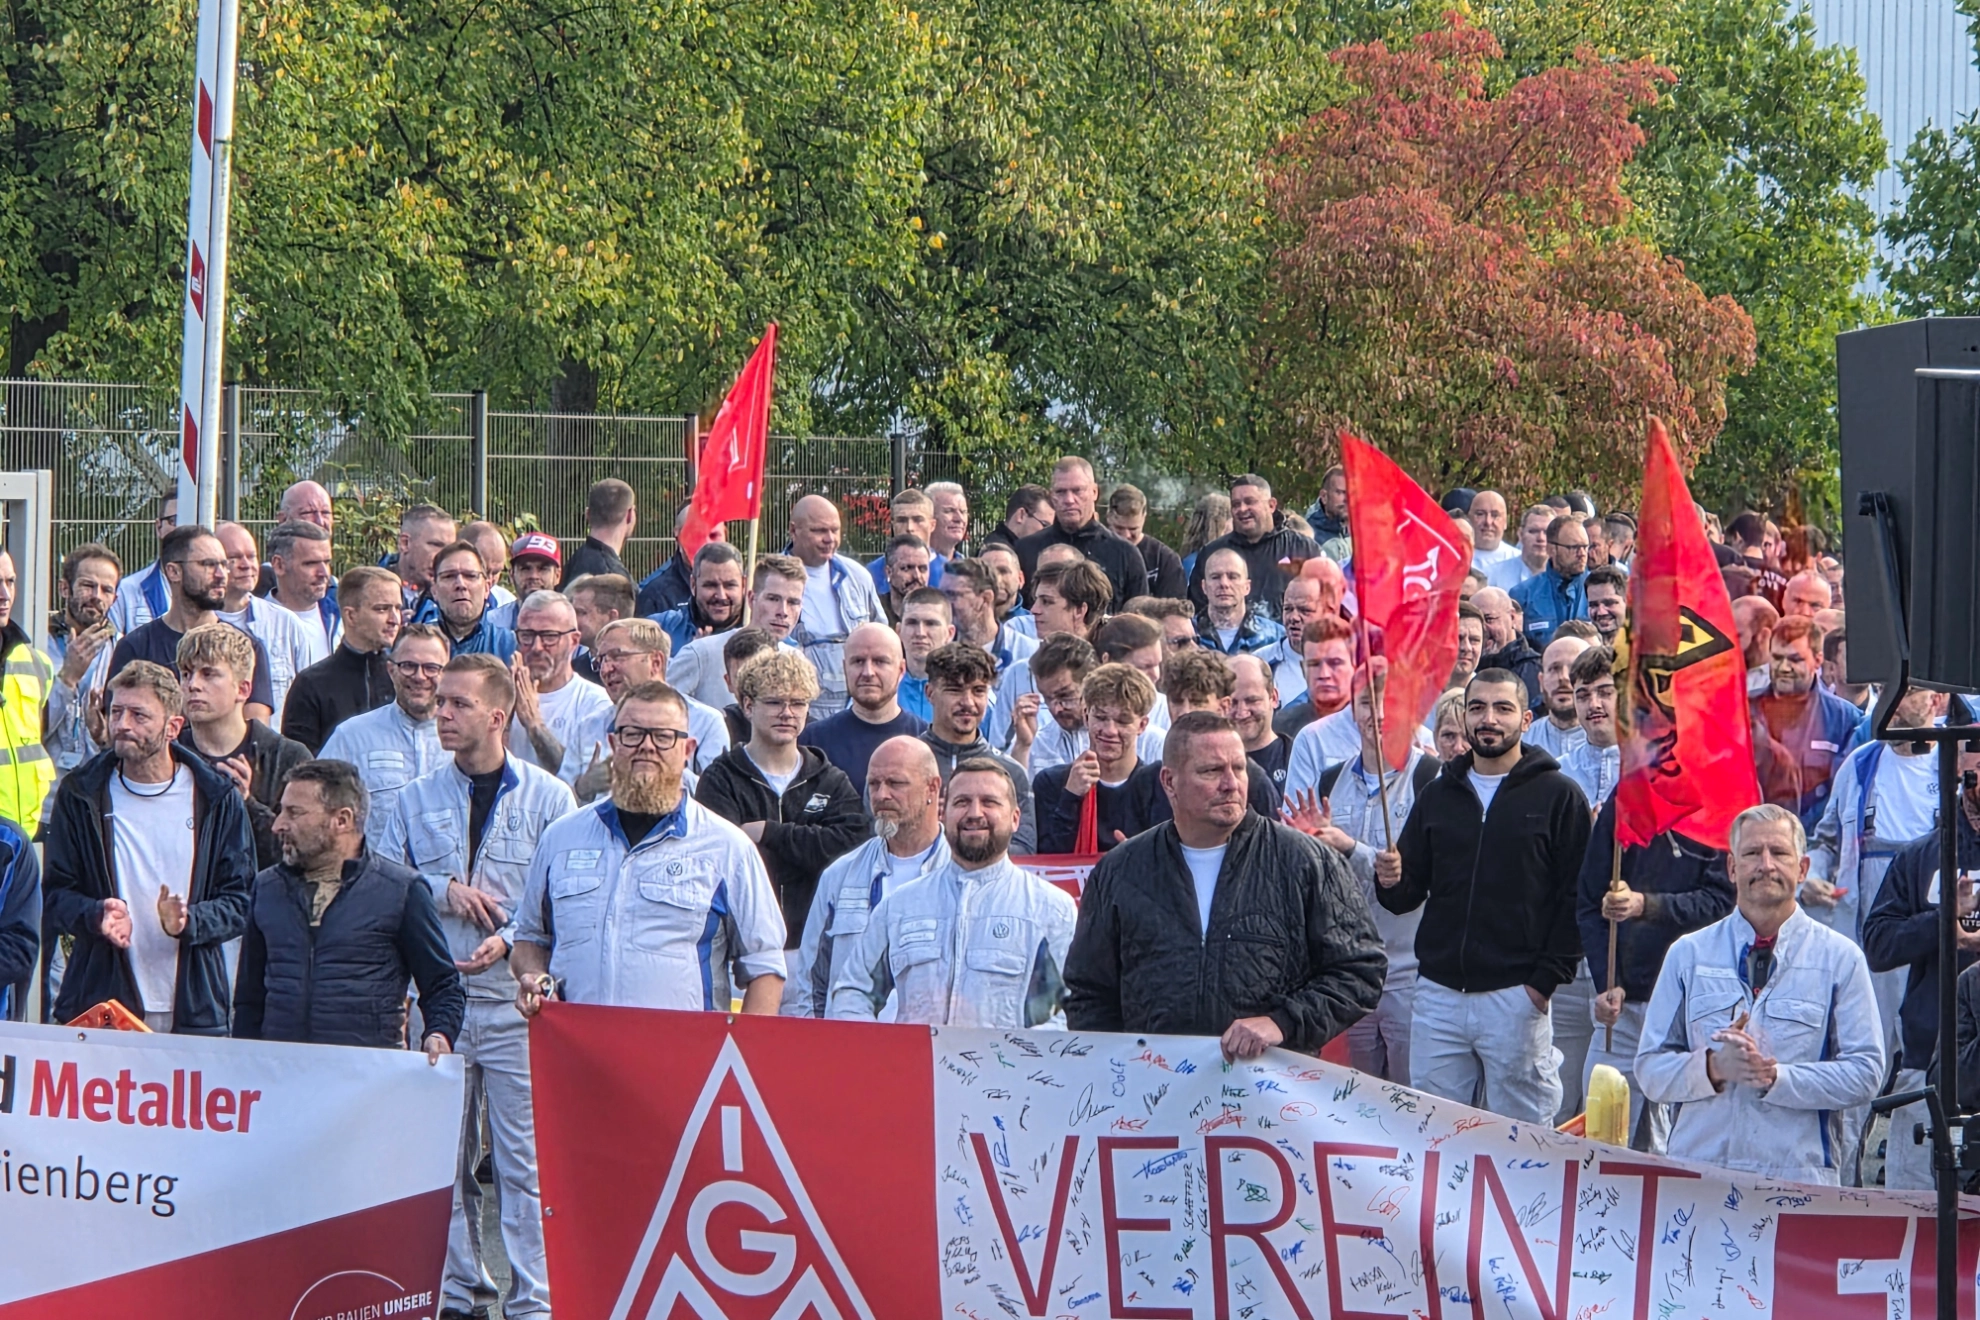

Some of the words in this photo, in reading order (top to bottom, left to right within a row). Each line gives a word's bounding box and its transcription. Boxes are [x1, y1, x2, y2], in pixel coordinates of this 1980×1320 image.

[526, 535, 557, 554] 93
[29, 1058, 262, 1134] Metaller
[0, 1149, 179, 1218] ienberg
[969, 1134, 1702, 1320] VEREINT
[336, 1303, 381, 1320] BAUEN
[383, 1290, 433, 1316] UNSERE
